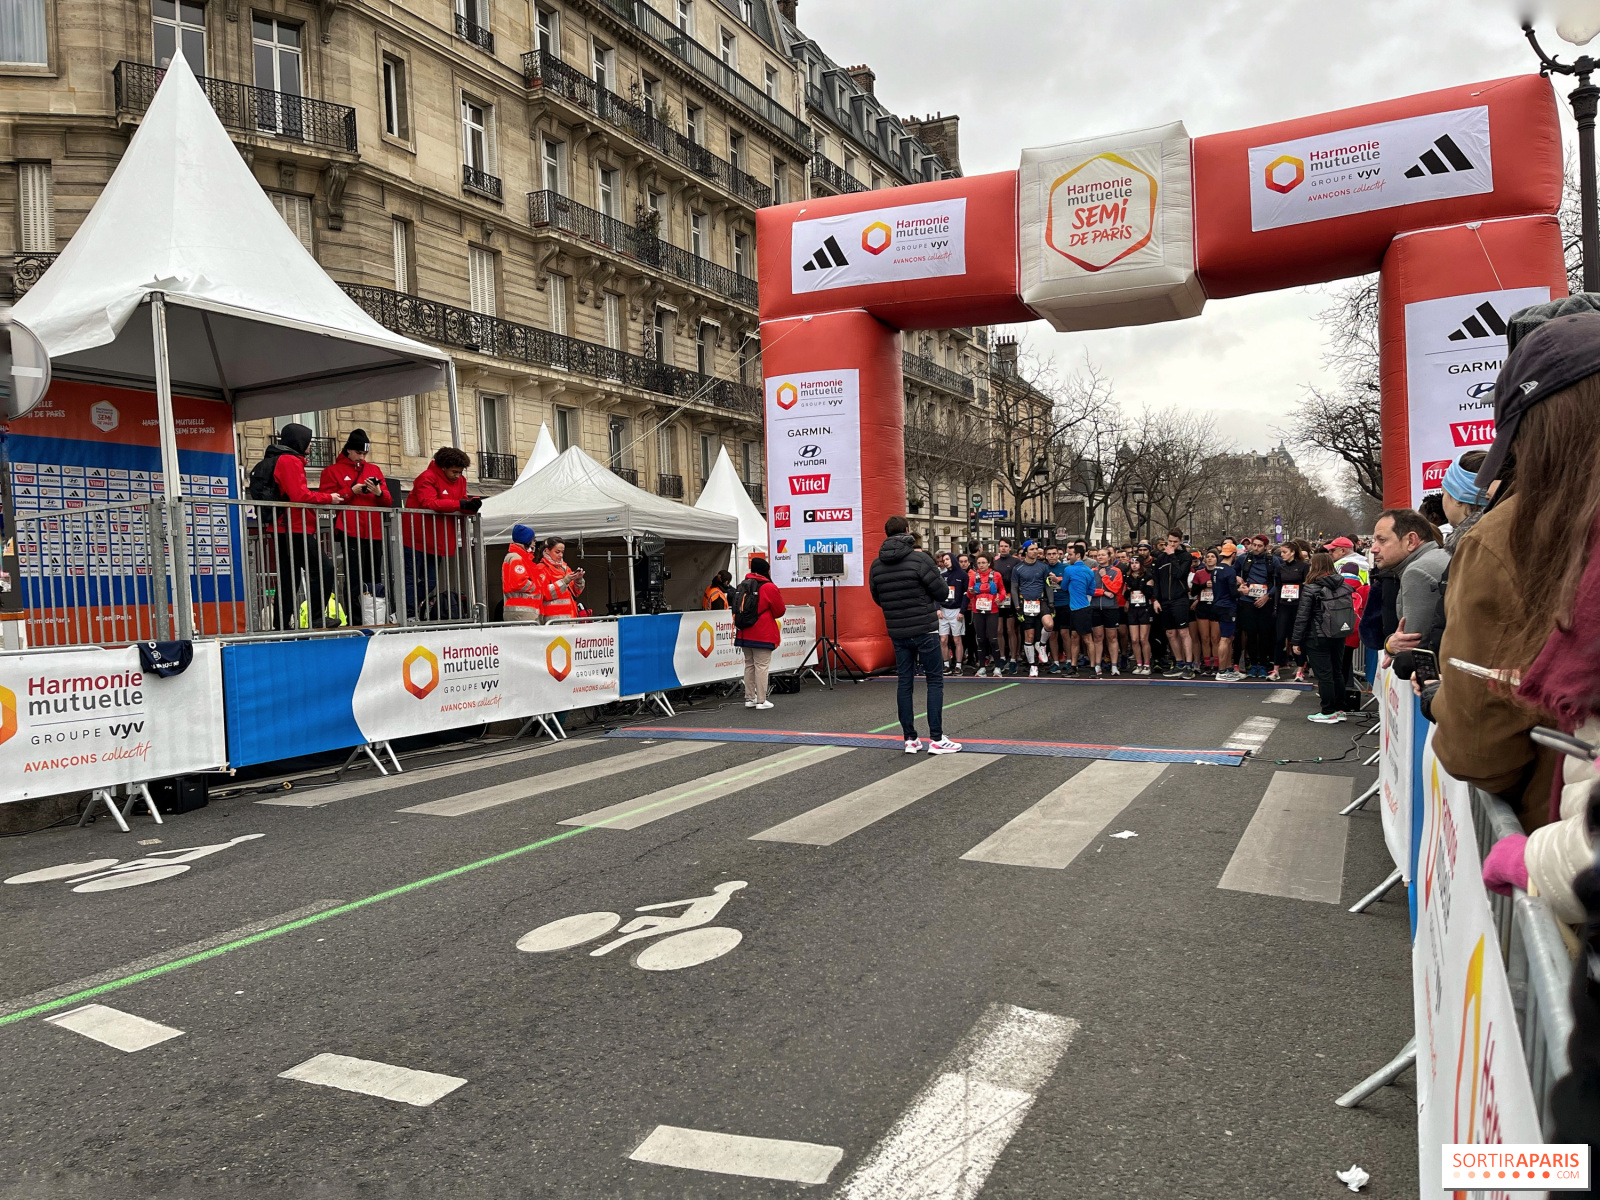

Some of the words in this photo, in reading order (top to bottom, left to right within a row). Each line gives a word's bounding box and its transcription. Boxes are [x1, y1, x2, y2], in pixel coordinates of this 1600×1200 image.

[1310, 141, 1380, 161] Harmonie
[1310, 150, 1380, 171] mutuelle
[1312, 174, 1352, 186] GROUPE
[1357, 168, 1381, 179] vyv
[1068, 177, 1132, 195] Harmonie
[1308, 189, 1350, 202] AVANÇONS
[1353, 180, 1386, 193] collectif
[1068, 188, 1132, 206] mutuelle
[897, 215, 949, 228] Harmonie
[897, 224, 949, 238] mutuelle
[931, 240, 948, 249] vyv
[1069, 232, 1089, 246] DE
[893, 256, 925, 264] AVANÇONS
[928, 251, 952, 262] collectif
[1448, 360, 1502, 374] GARMI
[801, 379, 842, 389] Harmonie
[801, 387, 842, 396] mutuelle
[792, 477, 826, 492] Vittel
[776, 512, 789, 520] RTL2
[782, 617, 806, 626] Harmonie
[782, 625, 806, 634] mutuelle
[575, 636, 614, 648] Harmonie
[443, 643, 499, 659] Harmonie
[575, 647, 614, 660] mutuelle
[444, 656, 499, 674] mutuelle
[576, 669, 599, 678] GROUPE
[601, 667, 614, 677] vyv
[28, 670, 143, 696] Harmonie
[444, 683, 478, 693] GROUPE
[481, 680, 499, 692] vyv
[573, 685, 598, 694] AVANÇONS
[29, 688, 143, 716] mutuelle
[441, 701, 476, 712] AVANÇONS
[477, 694, 502, 708] collectif
[31, 728, 101, 745] GROUPE
[109, 721, 144, 739] vyv
[24, 753, 97, 773] AVANÇONS
[102, 741, 152, 762] collectif
